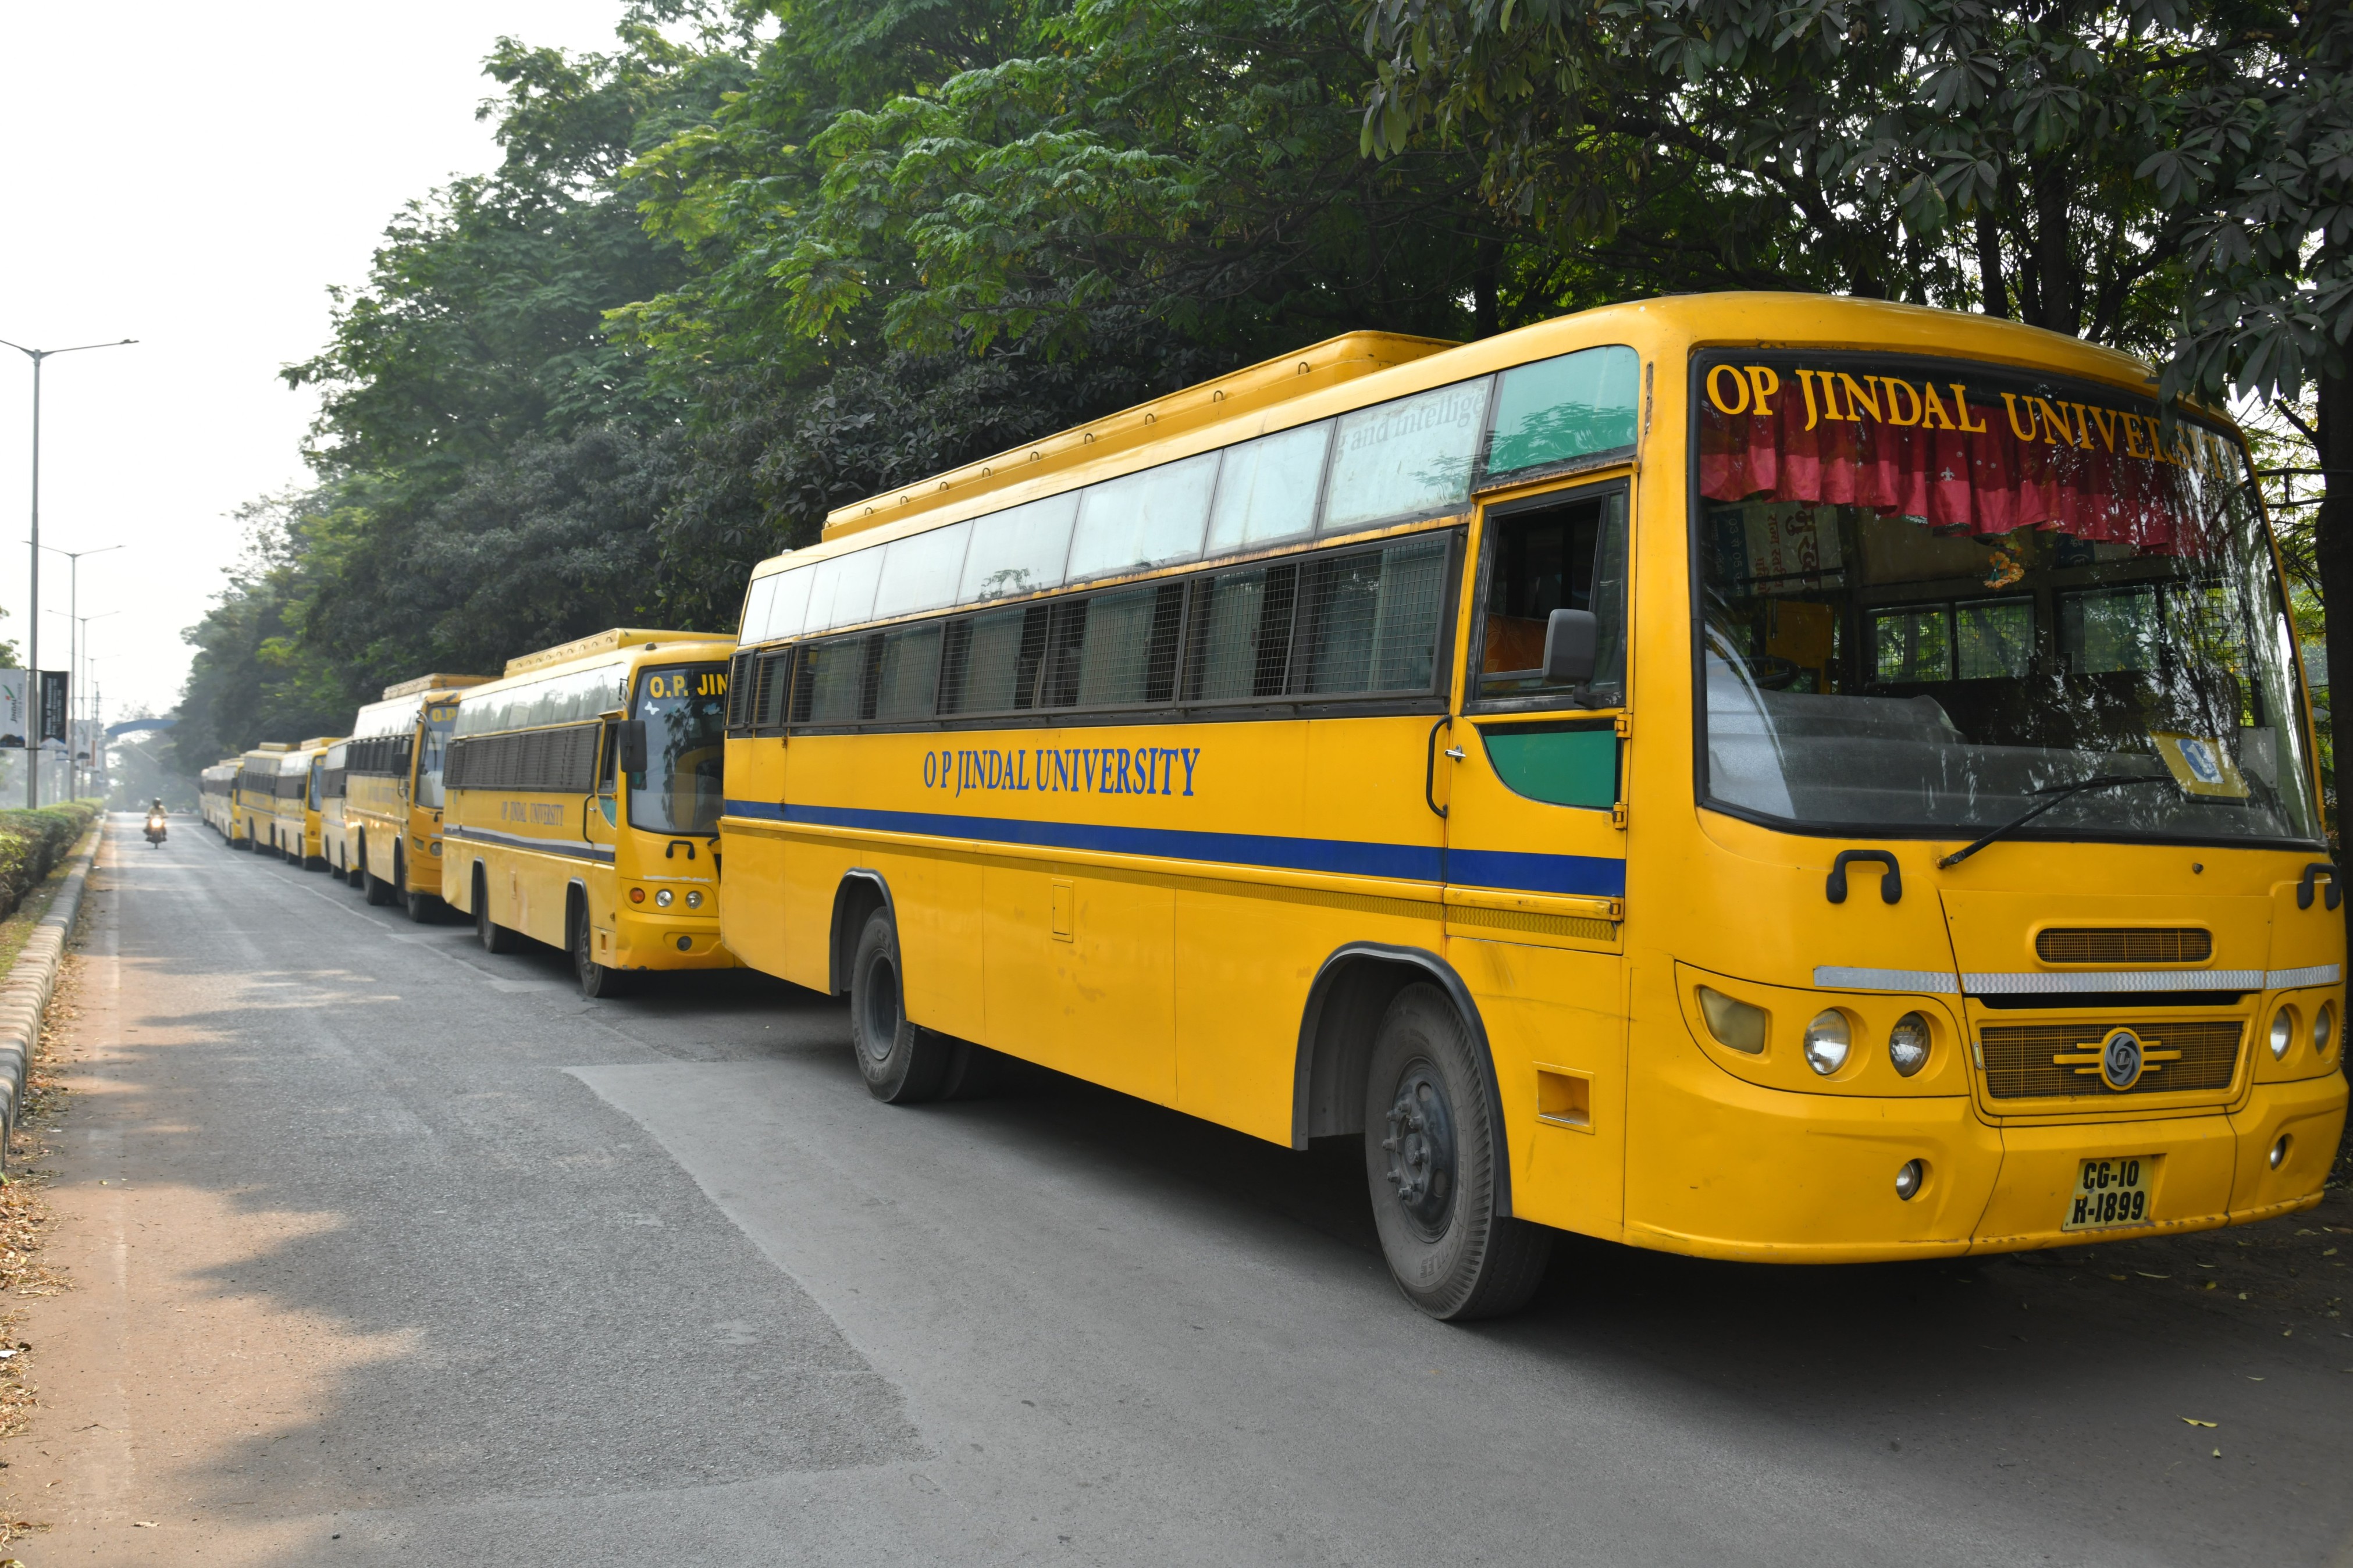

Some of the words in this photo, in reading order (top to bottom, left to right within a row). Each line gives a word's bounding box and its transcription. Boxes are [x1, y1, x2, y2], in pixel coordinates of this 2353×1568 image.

[1706, 364, 1779, 415] OP
[1795, 369, 1987, 433] JINDAL
[1351, 415, 1390, 450] and
[1728, 518, 1739, 534] 03
[1732, 553, 1743, 568] 05
[955, 749, 1030, 799] JINDAL
[1035, 747, 1201, 796] UNIVERSITY
[2083, 1160, 2140, 1189] CG-10
[2071, 1191, 2145, 1224] R-1899
